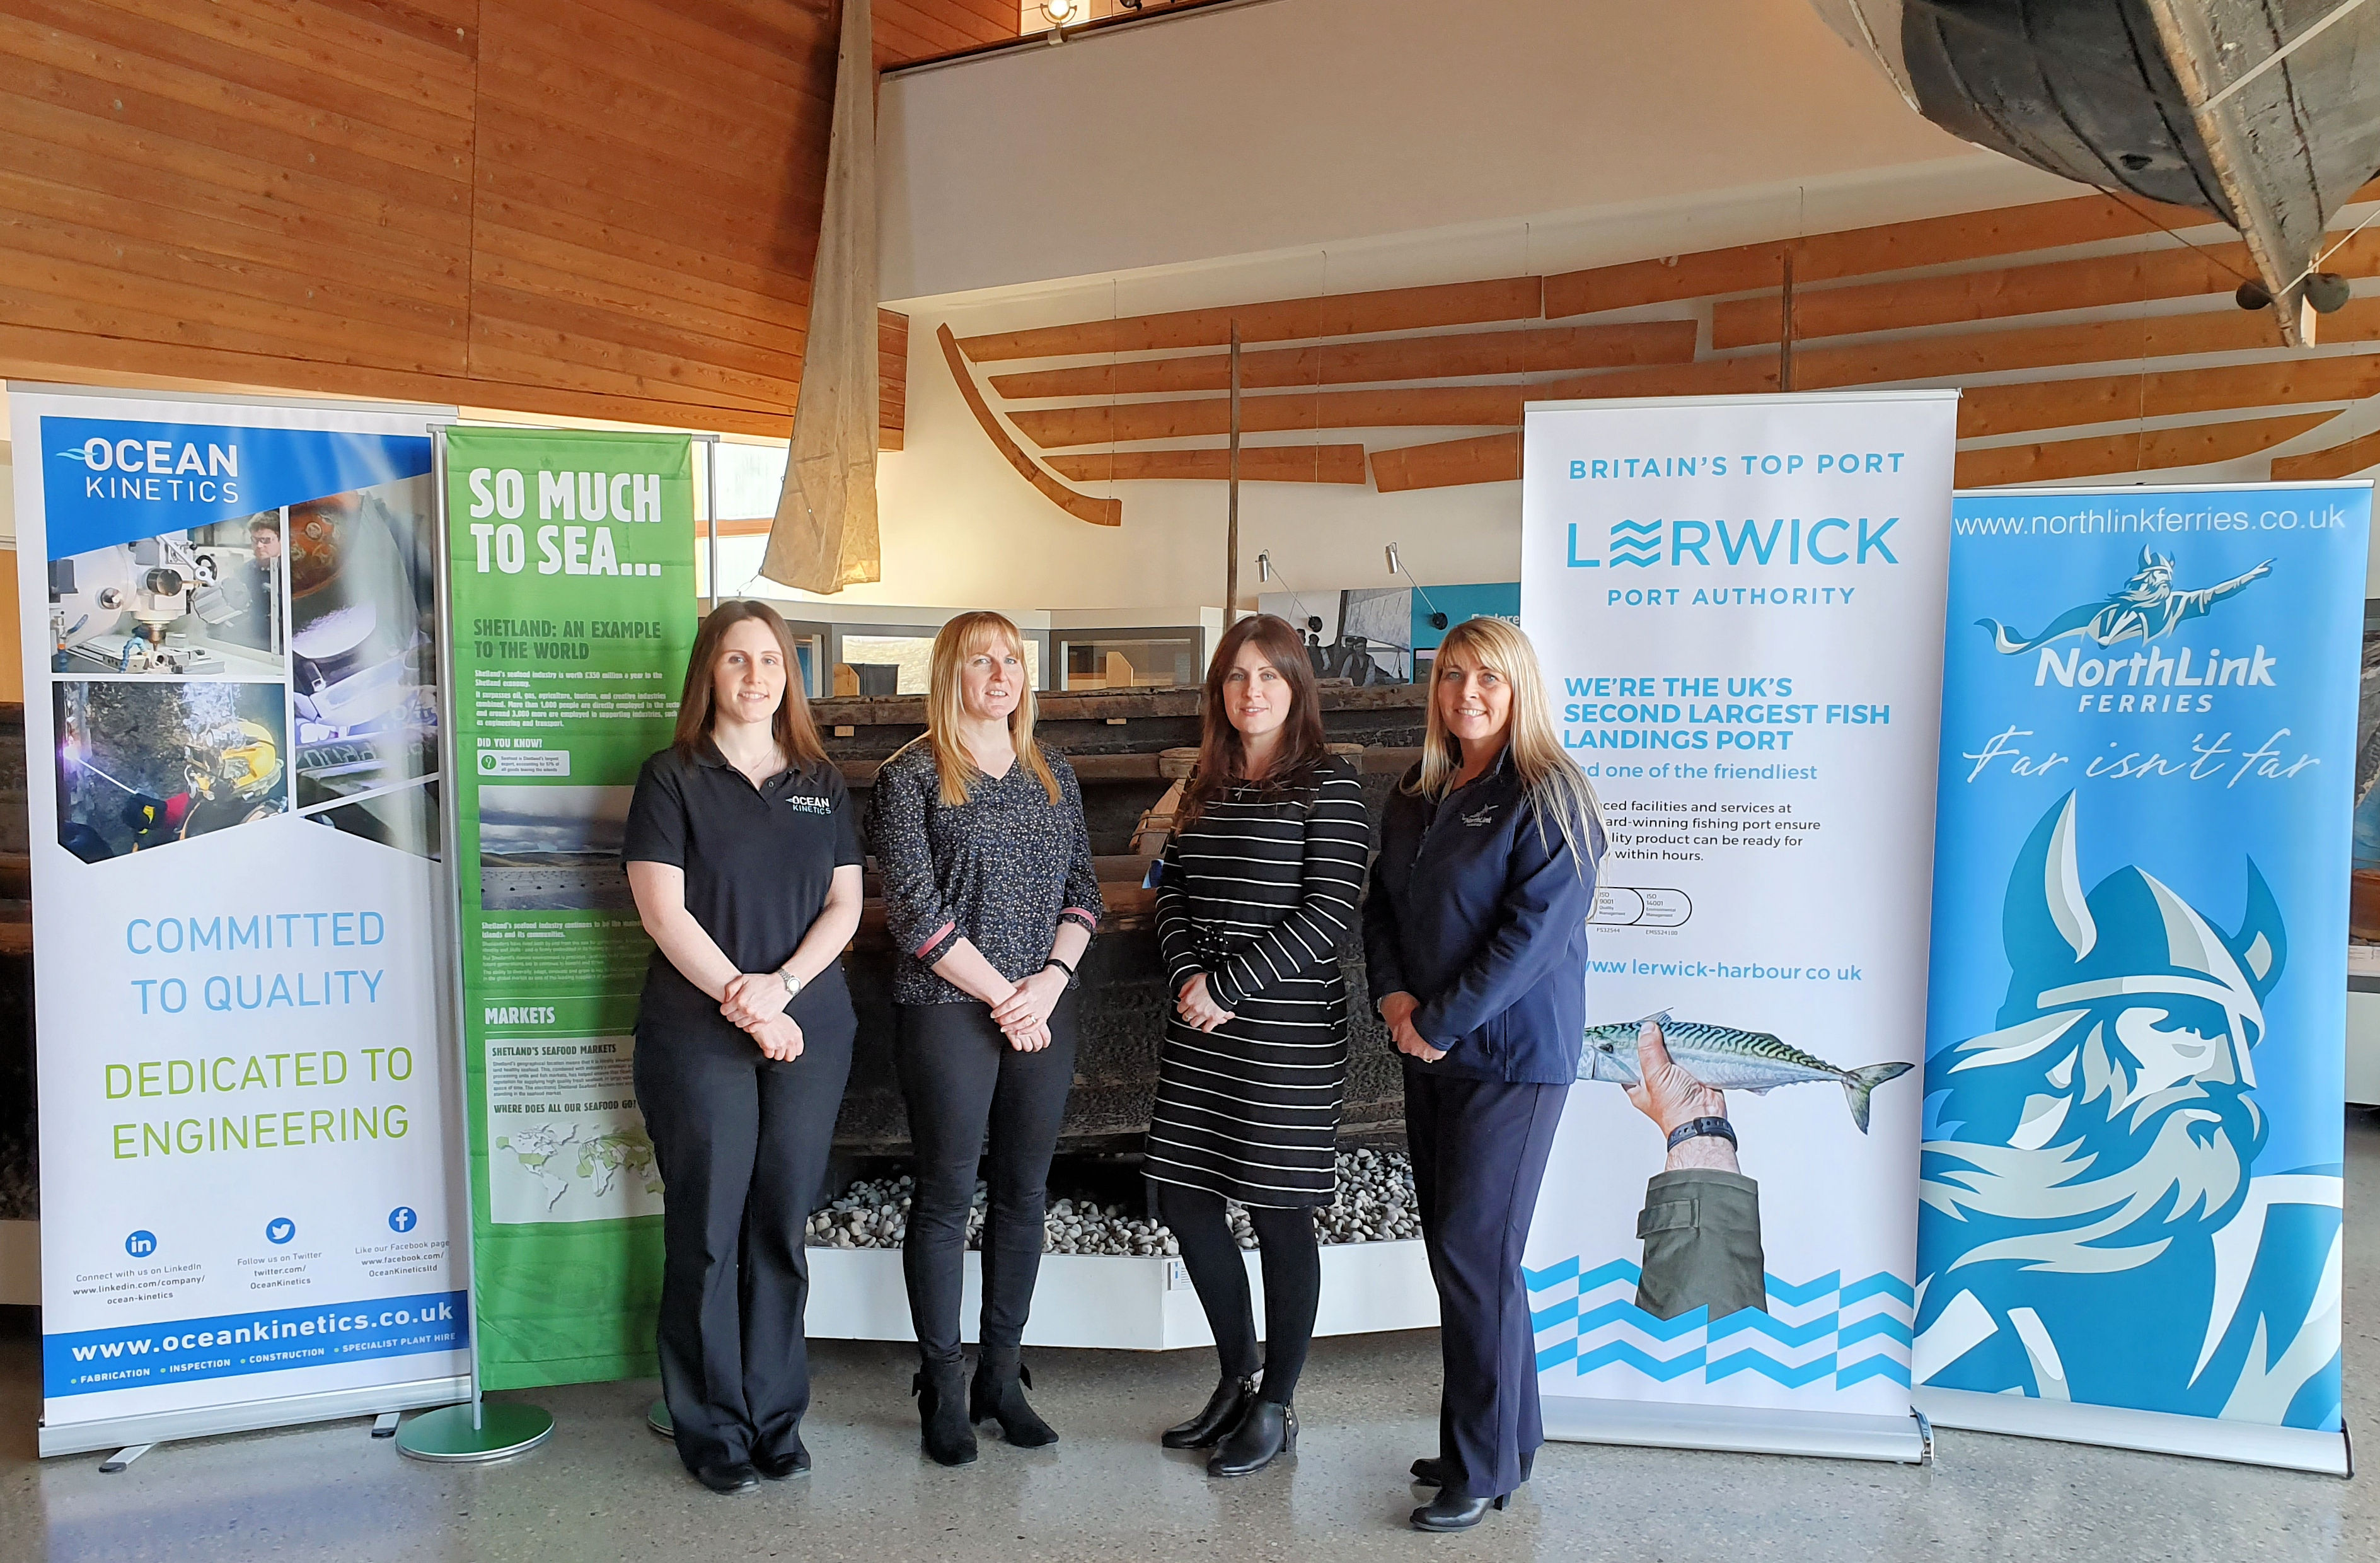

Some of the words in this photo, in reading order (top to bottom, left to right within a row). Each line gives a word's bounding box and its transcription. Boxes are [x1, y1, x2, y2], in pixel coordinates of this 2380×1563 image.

[84, 438, 238, 477] OCEAN
[1569, 456, 1727, 479] BRITAIN'S
[1742, 455, 1803, 475] TOP
[1818, 453, 1905, 474] PORT
[86, 477, 239, 503] KINETICS
[469, 468, 524, 520] SO
[538, 470, 662, 523] MUCH
[1955, 504, 2346, 536] www.northlinkferries.co.uk
[470, 523, 525, 574] TO
[537, 524, 662, 577] SEA...
[1608, 589, 1679, 606] PORT
[1692, 588, 1855, 605] AUTHORITY
[474, 619, 557, 638] SHETLAND:
[563, 620, 584, 638] AN
[591, 621, 661, 639] EXAMPLE
[475, 641, 493, 658] TO
[499, 641, 528, 659] THE
[533, 642, 590, 660] WORLD
[2035, 644, 2278, 687] NorthLink
[1564, 678, 1655, 697] WE'RE
[1663, 678, 1719, 697] THE
[1728, 677, 1792, 697] UK'S
[2078, 694, 2212, 712] FERRIES
[1564, 704, 1680, 724] SECOND
[1689, 704, 1818, 724] LARGEST
[1827, 704, 1890, 724] FISH
[477, 737, 491, 747] DID
[494, 738, 511, 748] YOU
[514, 738, 543, 748] KNOW?
[1564, 730, 1708, 749] LANDINGS
[1716, 730, 1793, 750] PORT
[1963, 725, 2069, 783] Far
[2086, 731, 2232, 781] isn't
[2227, 728, 2320, 789] far
[1605, 766, 1643, 777] one
[1649, 763, 1670, 777] of
[1674, 763, 1707, 779] the
[1714, 763, 1818, 780] friendliest
[792, 796, 829, 808] OCEAN
[793, 805, 831, 815] KINETICS
[1632, 800, 1687, 812] facilities
[1691, 802, 1717, 813] and
[1721, 803, 1774, 814] services
[1779, 803, 1792, 814] at
[1692, 818, 1738, 832] fishing
[1742, 819, 1771, 832] port
[1774, 820, 1821, 830] ensure
[1636, 833, 1690, 845] product
[1693, 835, 1718, 845] can
[1721, 834, 1740, 846] be
[1742, 835, 1781, 849] ready
[1784, 835, 1803, 847] for
[1615, 849, 1658, 860] within
[1662, 849, 1704, 862] hours.
[127, 911, 384, 954] COMMITTED
[132, 978, 187, 1014] TO
[205, 969, 383, 1012] QUALITY
[485, 1006, 555, 1025] MARKETS
[492, 1046, 539, 1057] SHETLAND'S
[542, 1045, 577, 1055] SEAFOOD
[580, 1043, 616, 1054] MARKETS
[105, 1050, 347, 1100] DEDICATED
[361, 1047, 413, 1081] TO
[494, 1103, 522, 1113] WHERE
[525, 1103, 545, 1113] DOES
[548, 1103, 561, 1112] ALL
[564, 1103, 581, 1112] OUR
[584, 1101, 618, 1111] SEAFOOD
[114, 1105, 408, 1159] ENGINEERING
[131, 1236, 151, 1253] in
[355, 1246, 372, 1255] Like
[390, 1241, 428, 1252] Facebook
[430, 1240, 450, 1249] page
[237, 1257, 266, 1266] Follow
[292, 1252, 322, 1260] Twitter
[361, 1252, 444, 1266] www.facebook.com/
[76, 1272, 112, 1282] Connect
[116, 1270, 134, 1278] with
[164, 1263, 202, 1274] LinkedIn
[254, 1265, 306, 1277] twitter.com/
[72, 1275, 205, 1295] www.linkedin.com/company/
[250, 1278, 311, 1290] OceanKinetics
[107, 1291, 173, 1304] ocean-kinetics
[72, 1301, 454, 1362] www.oceankinetics.co.uk
[81, 1368, 150, 1384] FABRICATION
[170, 1359, 231, 1373] INSPECTION
[250, 1347, 324, 1364] CONSTRUCTION
[342, 1339, 398, 1353] SPECIALIST
[400, 1335, 430, 1345] PLANT
[434, 1332, 456, 1342] HIRE
